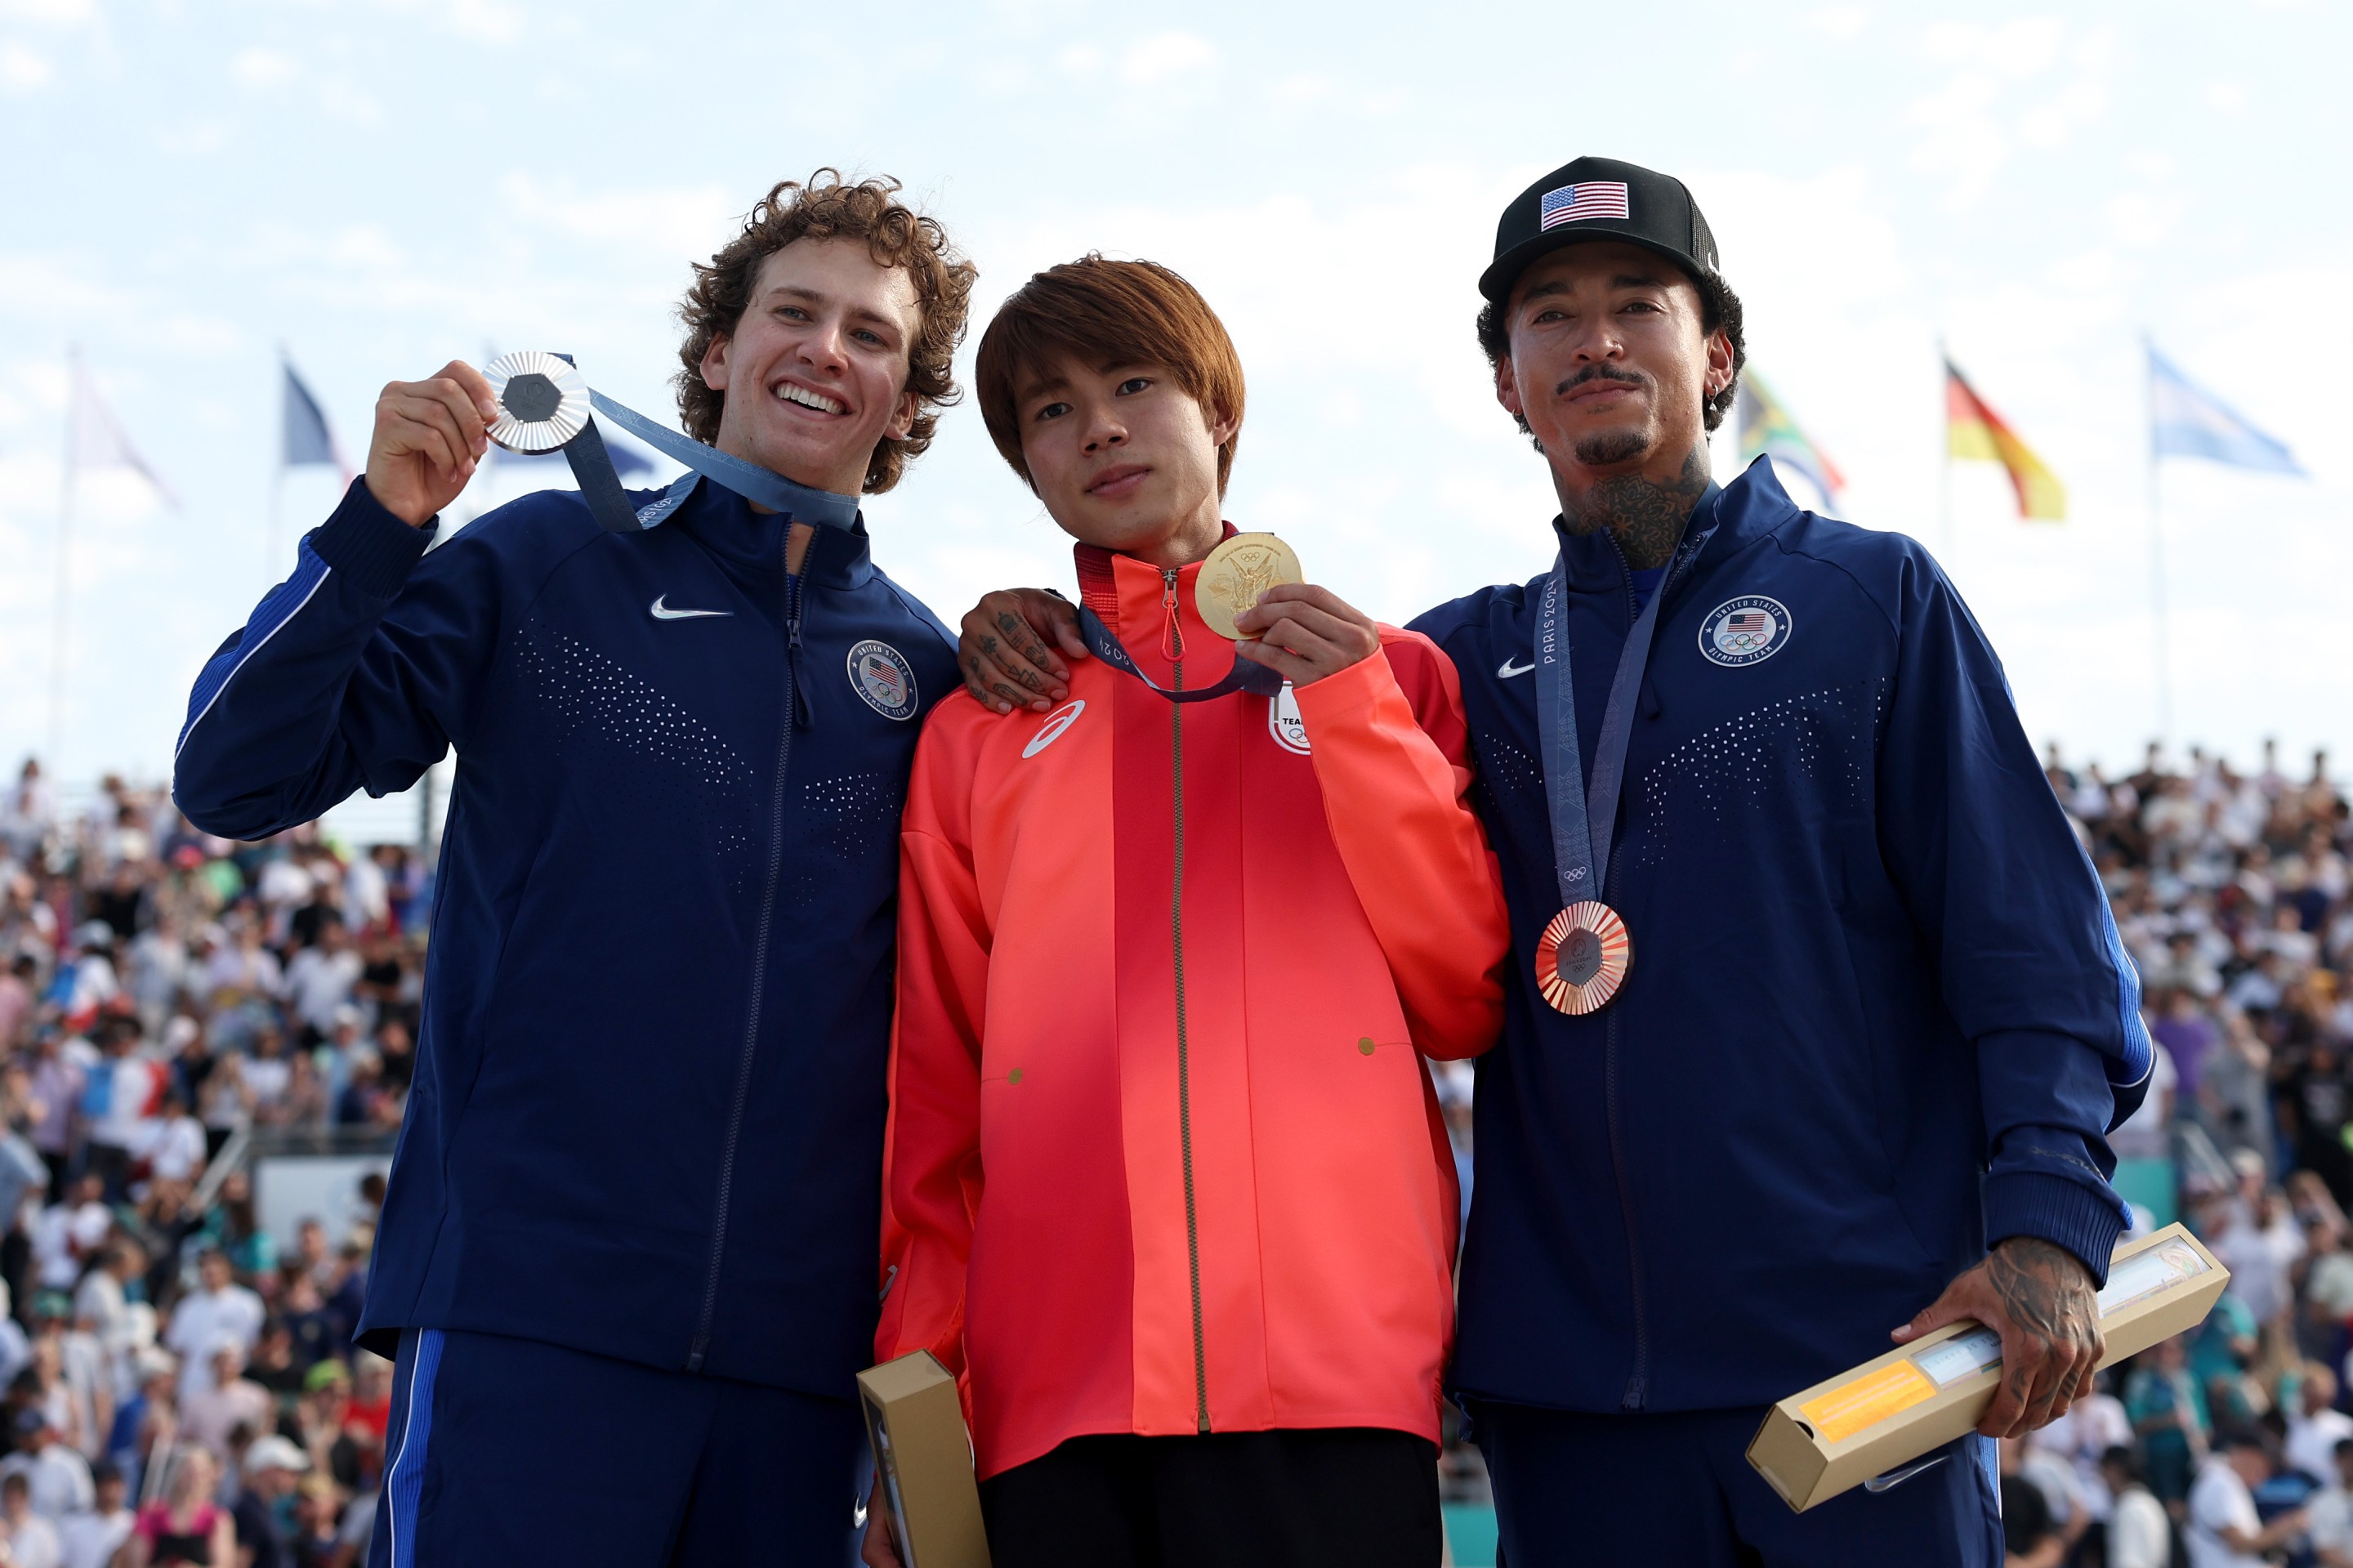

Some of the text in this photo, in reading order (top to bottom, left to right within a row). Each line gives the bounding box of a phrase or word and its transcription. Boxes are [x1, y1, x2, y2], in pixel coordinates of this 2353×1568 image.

[1544, 579, 1556, 618] 2024
[1716, 600, 1782, 619] UNITED STATES
[857, 645, 909, 677] UNITED STATES
[1708, 646, 1773, 663] OLYMPIC TEAM
[859, 686, 909, 716] OLYMPIC TEAM
